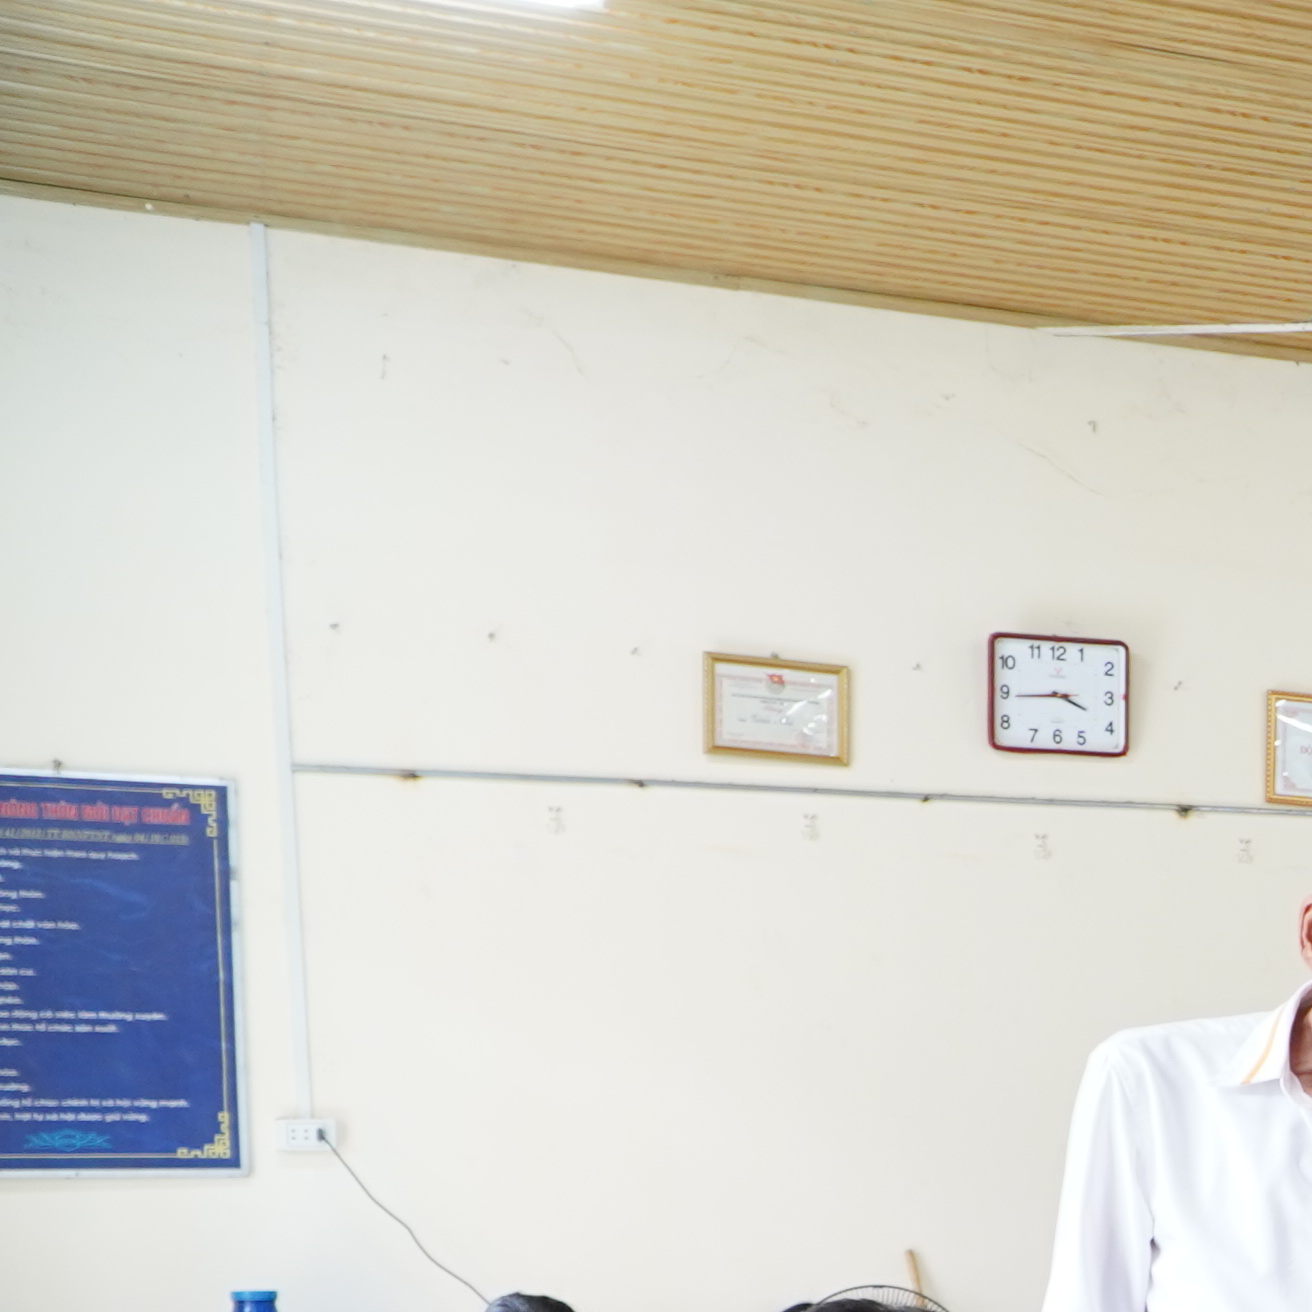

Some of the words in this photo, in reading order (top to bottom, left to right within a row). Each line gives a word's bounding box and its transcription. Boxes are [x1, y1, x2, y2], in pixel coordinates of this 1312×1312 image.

[1028, 644, 1041, 659] 11
[1049, 645, 1067, 661] 12
[1078, 647, 1084, 662] 1
[998, 654, 1016, 670] 10
[1104, 661, 1115, 676] 2
[1000, 684, 1010, 700] 9
[1104, 691, 1115, 706] 3
[1000, 714, 1011, 730] 8
[1105, 721, 1115, 735] 4
[1028, 728, 1039, 743] 7
[1052, 729, 1063, 745] 6
[1076, 730, 1087, 746] 5
